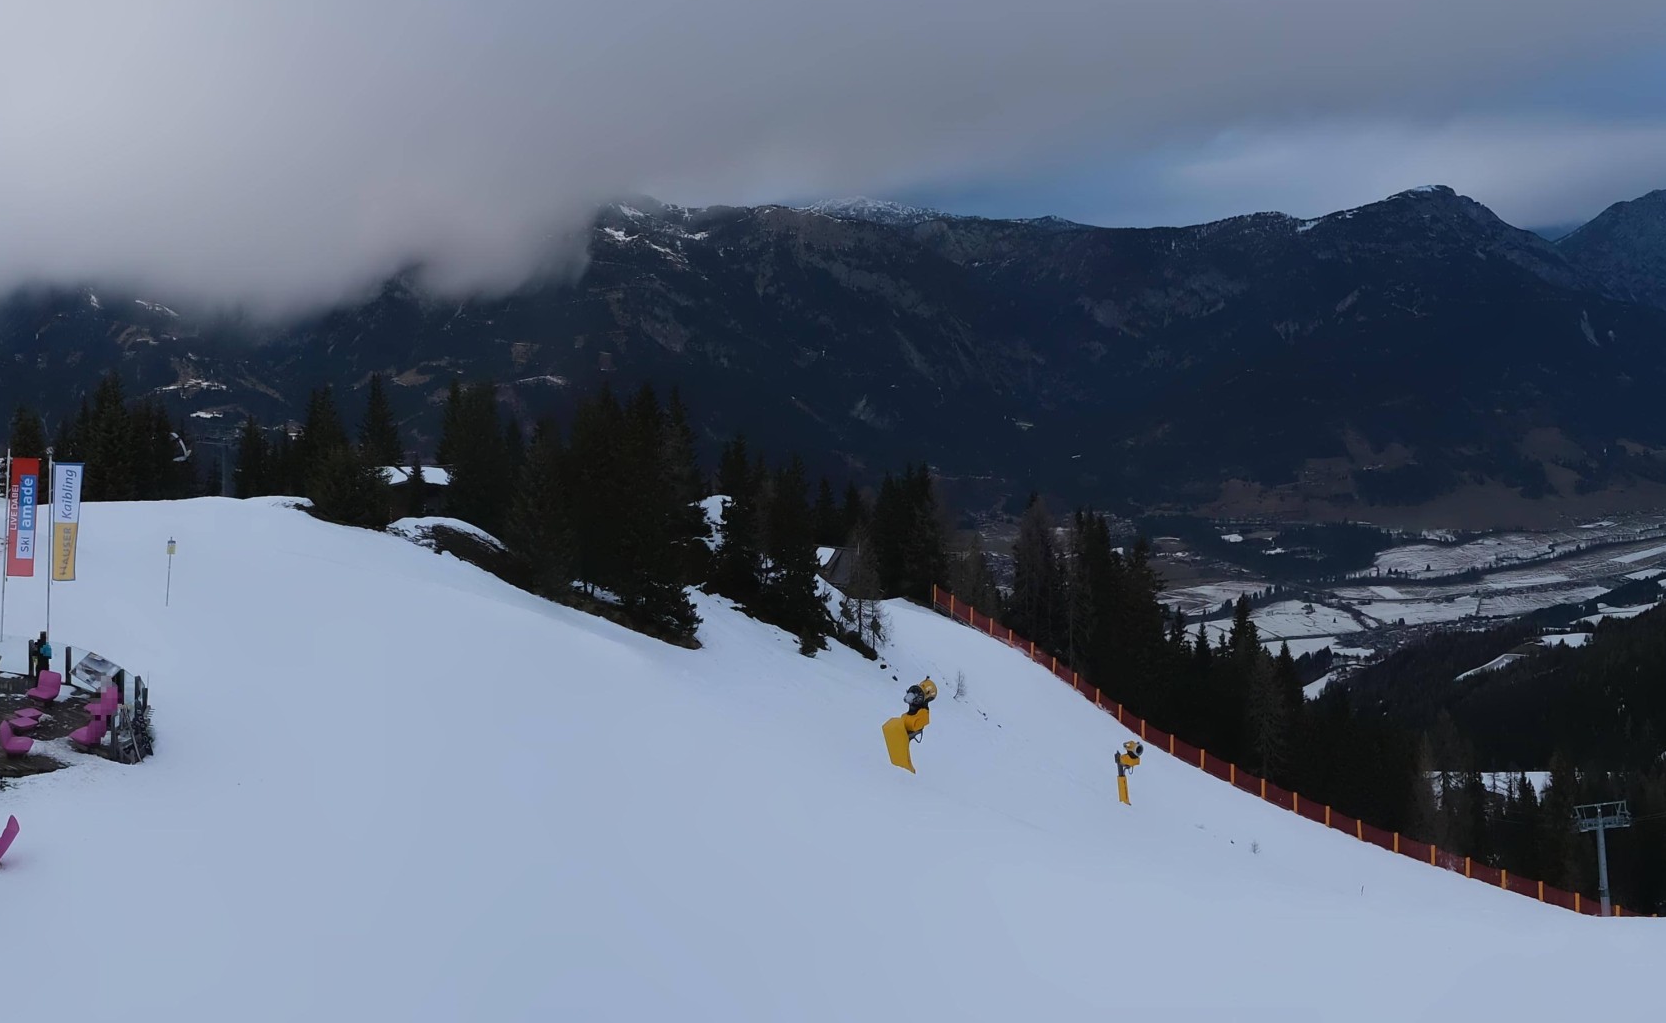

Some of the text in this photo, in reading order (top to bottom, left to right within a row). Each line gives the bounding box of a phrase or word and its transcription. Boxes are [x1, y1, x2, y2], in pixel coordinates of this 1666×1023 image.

[9, 484, 19, 530] LIVE DABEI
[60, 468, 77, 576] HAUSER Kaibling
[20, 537, 30, 552] Ski
